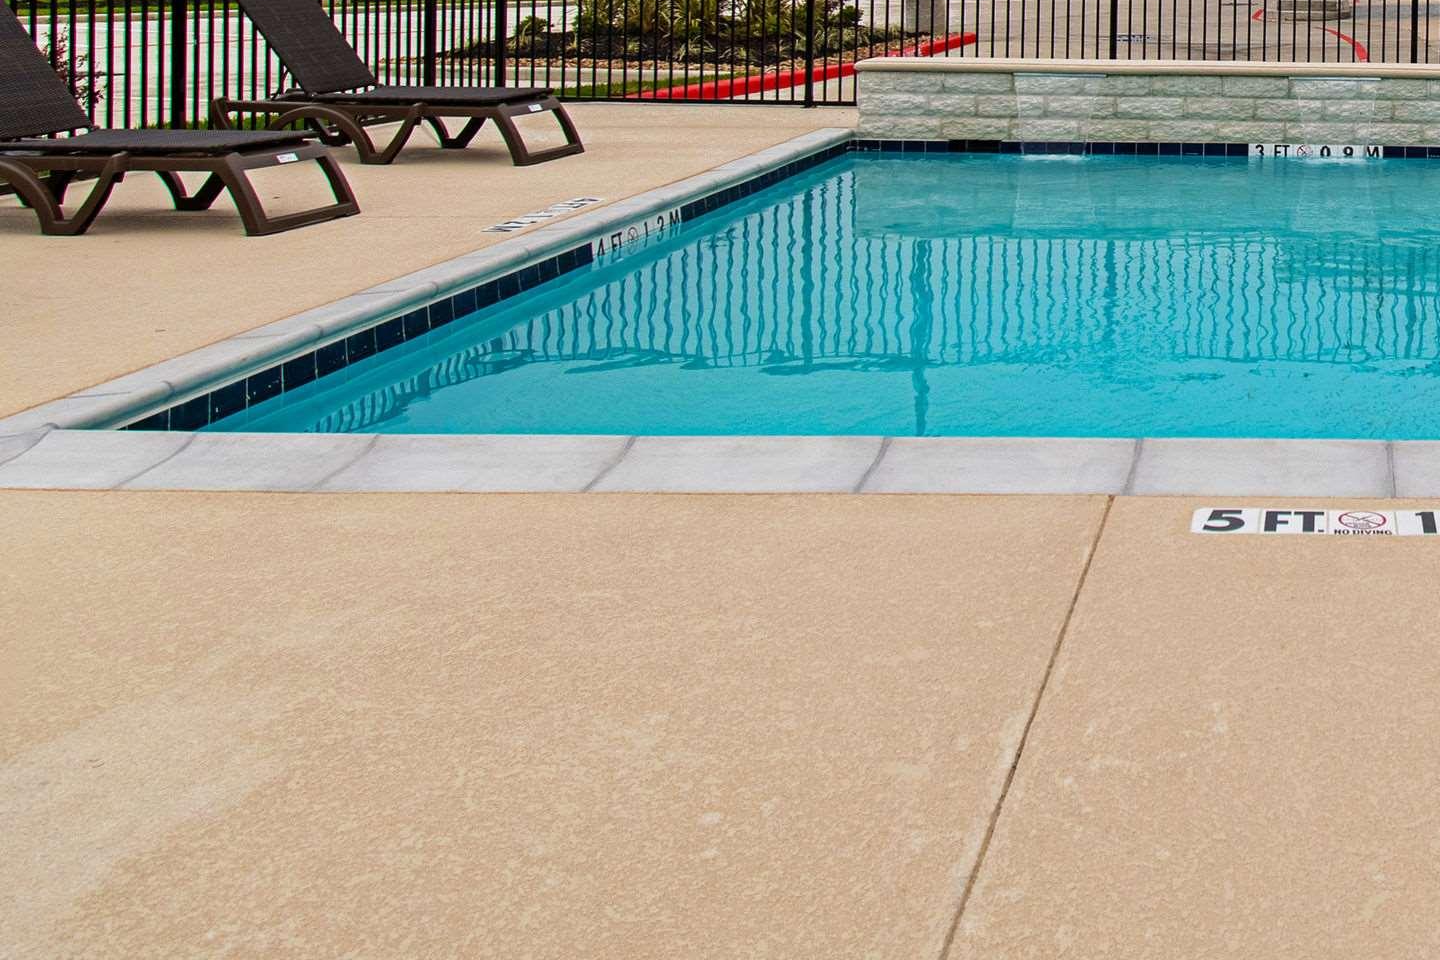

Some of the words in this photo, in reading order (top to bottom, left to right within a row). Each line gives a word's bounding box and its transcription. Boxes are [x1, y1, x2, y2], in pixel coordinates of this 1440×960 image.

[1255, 144, 1264, 157] 3
[1274, 144, 1290, 157] FT
[1366, 145, 1379, 157] M
[611, 231, 622, 251] FT
[669, 208, 680, 227] M
[1202, 509, 1245, 532] 5
[1263, 510, 1325, 533] FT.
